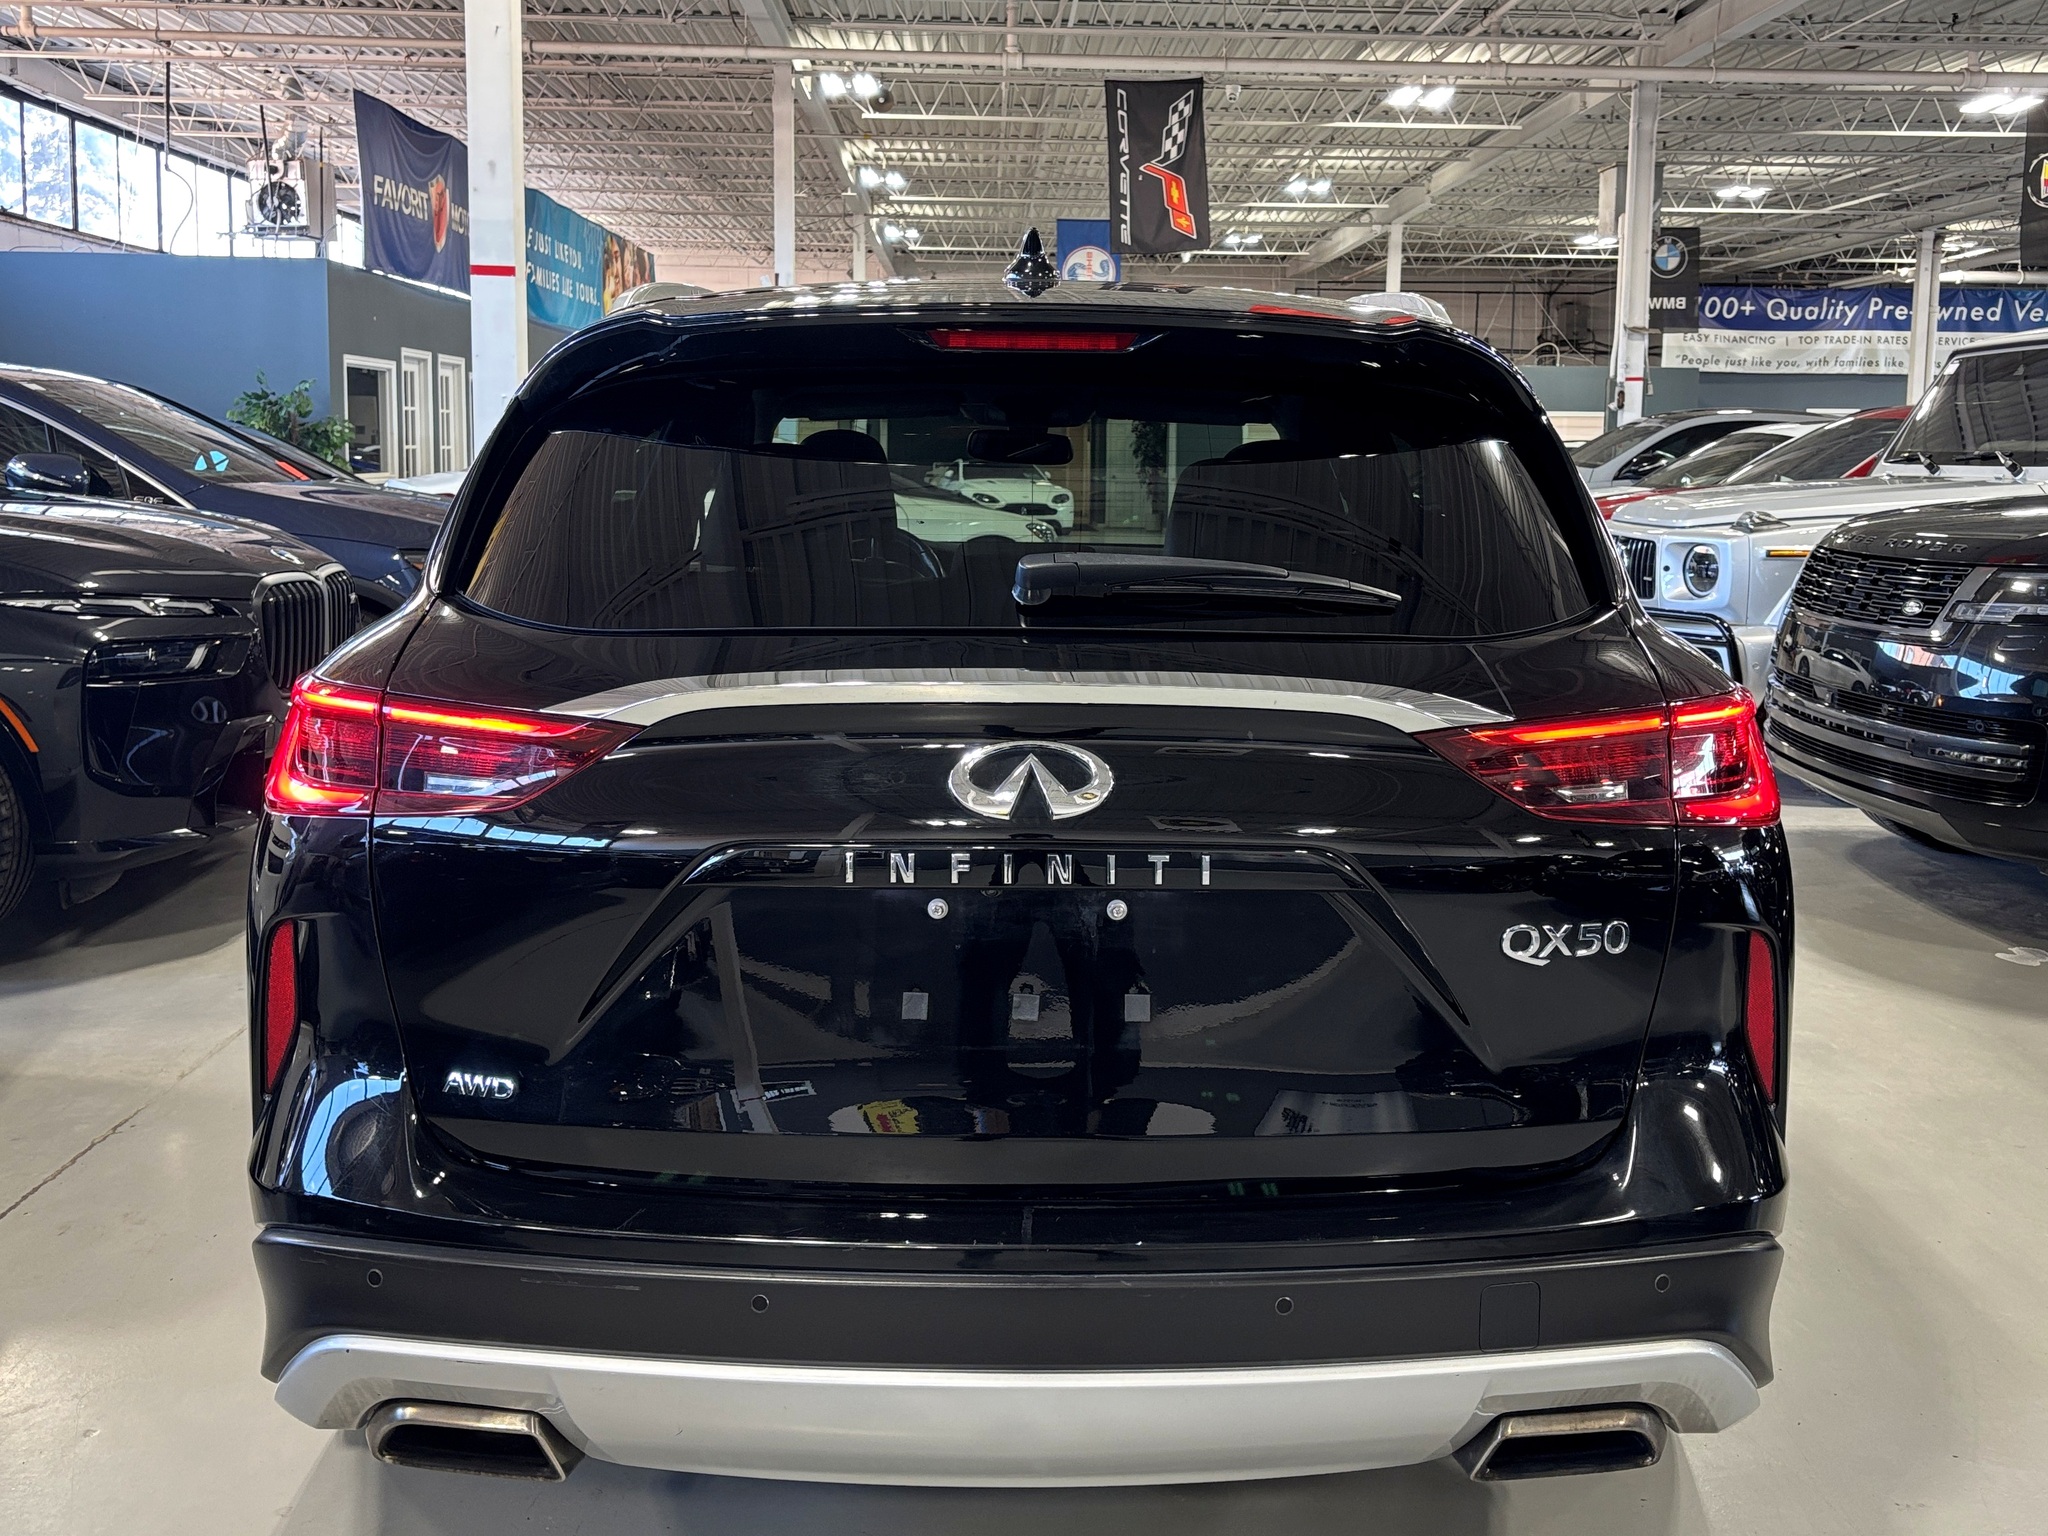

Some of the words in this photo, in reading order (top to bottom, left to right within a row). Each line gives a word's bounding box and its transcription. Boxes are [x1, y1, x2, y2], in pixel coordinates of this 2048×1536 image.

[1117, 88, 1131, 246] CORVETTE
[374, 174, 428, 221] FAVORIT
[534, 231, 551, 257] JUST
[1766, 296, 1859, 327] Quality
[1683, 333, 1711, 344] EASY
[1714, 334, 1776, 345] FINANCING
[1798, 335, 1820, 345] TOP
[1824, 335, 1872, 346] TRADE-IN
[1877, 335, 1909, 346] RATES
[1936, 336, 1976, 346] ERVICE
[1724, 355, 1747, 368] just
[1750, 355, 1772, 367] like
[1776, 357, 1800, 369] you,
[1806, 356, 1829, 368] with
[1834, 356, 1880, 369] families
[1884, 356, 1904, 368] like
[845, 852, 1211, 886] INFINITI
[1502, 920, 1631, 967] QX50
[442, 1071, 515, 1100] AWD
